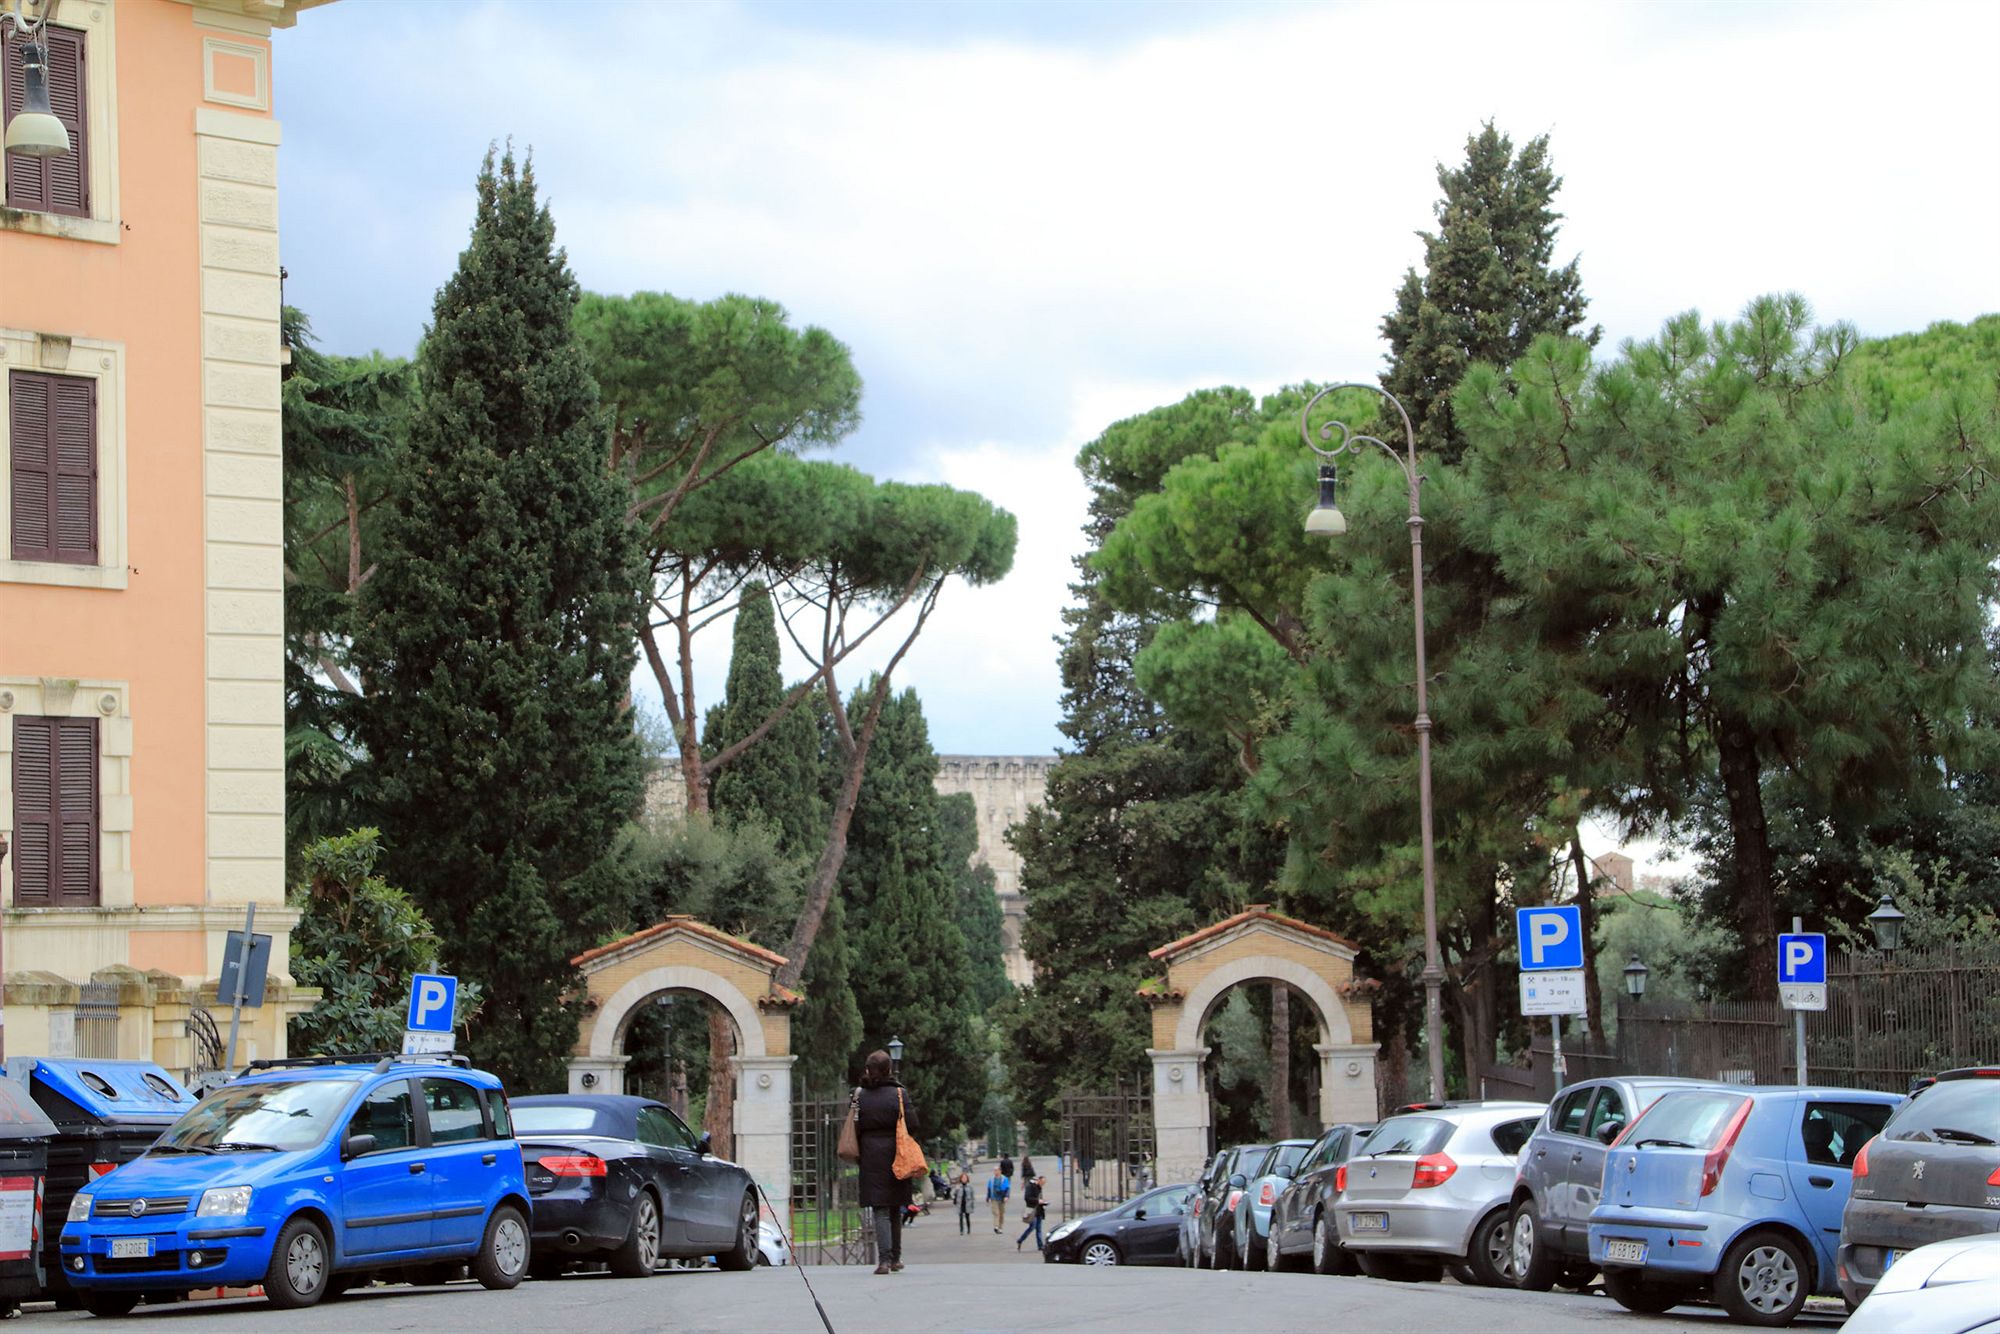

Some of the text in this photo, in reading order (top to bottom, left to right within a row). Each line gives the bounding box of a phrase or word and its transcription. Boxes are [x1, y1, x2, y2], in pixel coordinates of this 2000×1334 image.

[1529, 913, 1569, 964] P
[1786, 941, 1813, 976] P
[416, 980, 447, 1025] P
